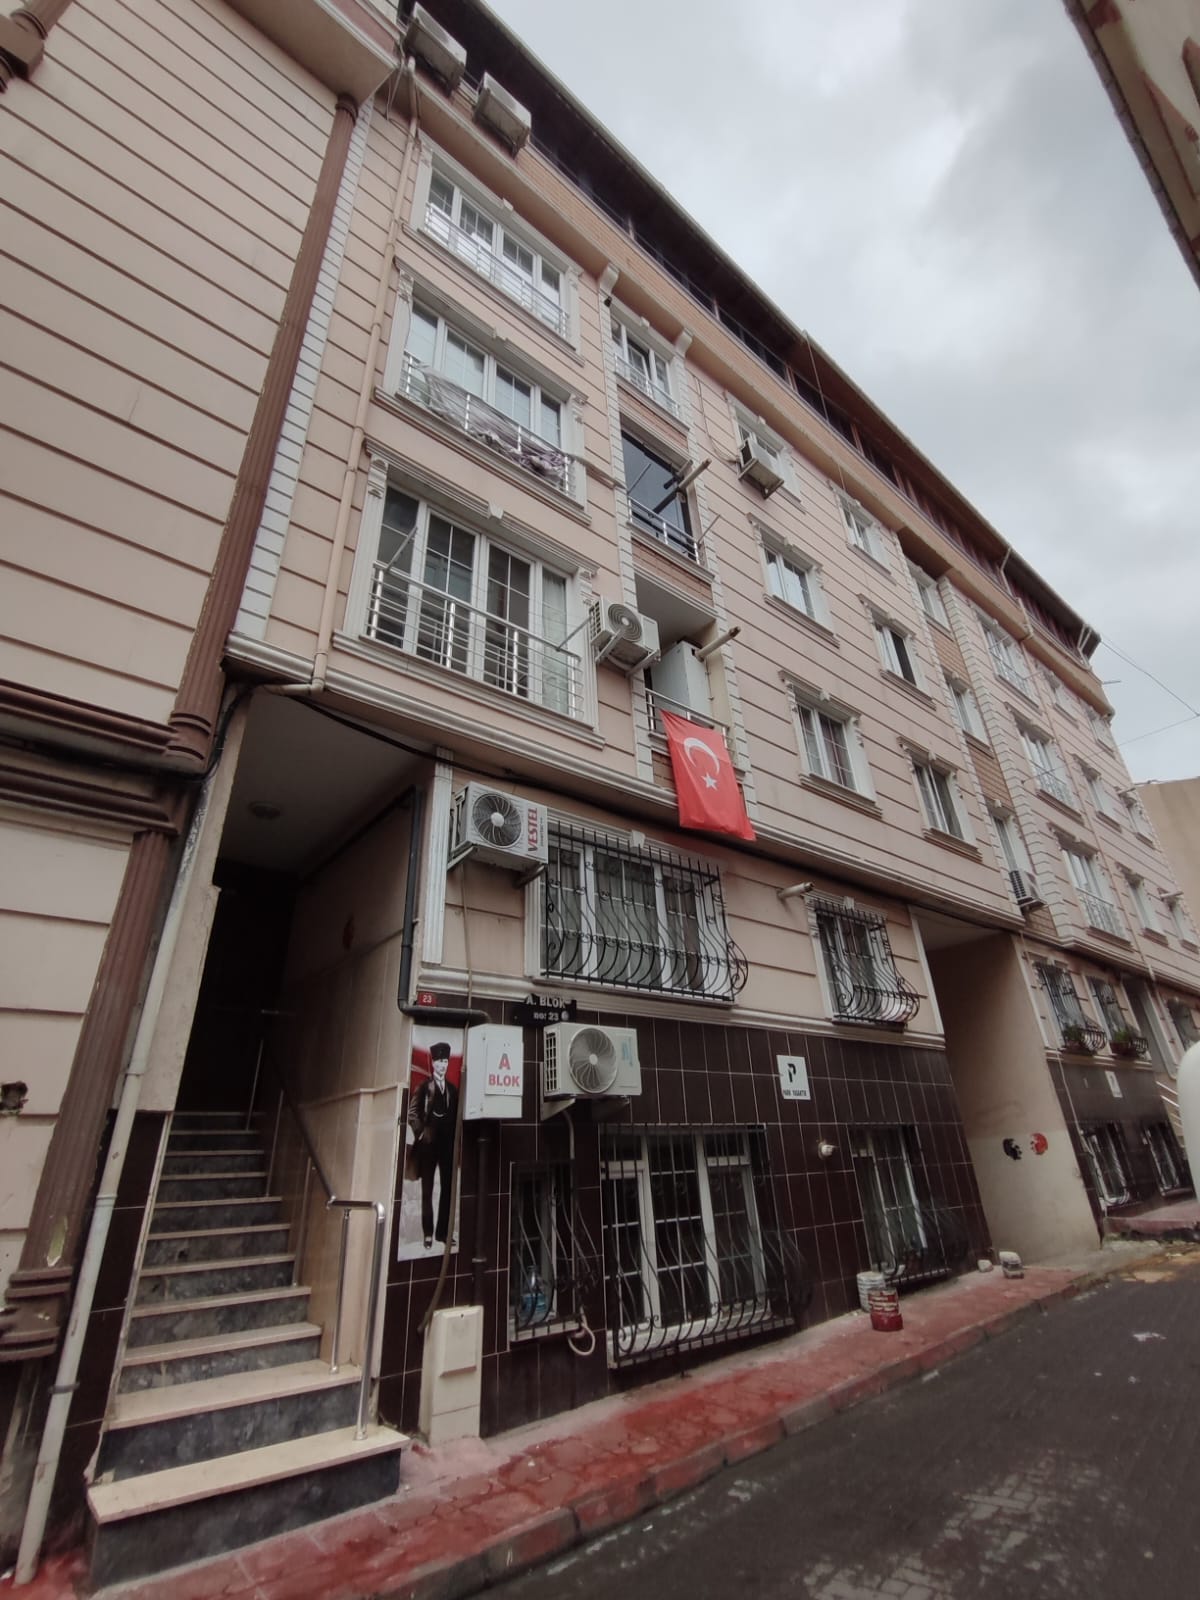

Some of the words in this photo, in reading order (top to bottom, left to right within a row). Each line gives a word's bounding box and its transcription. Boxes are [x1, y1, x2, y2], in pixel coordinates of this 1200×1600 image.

[527, 808, 538, 852] VESTEL
[540, 995, 566, 1008] BLOK
[499, 1053, 511, 1070] A
[489, 1074, 520, 1087] BLOK
[787, 1063, 796, 1082] P
